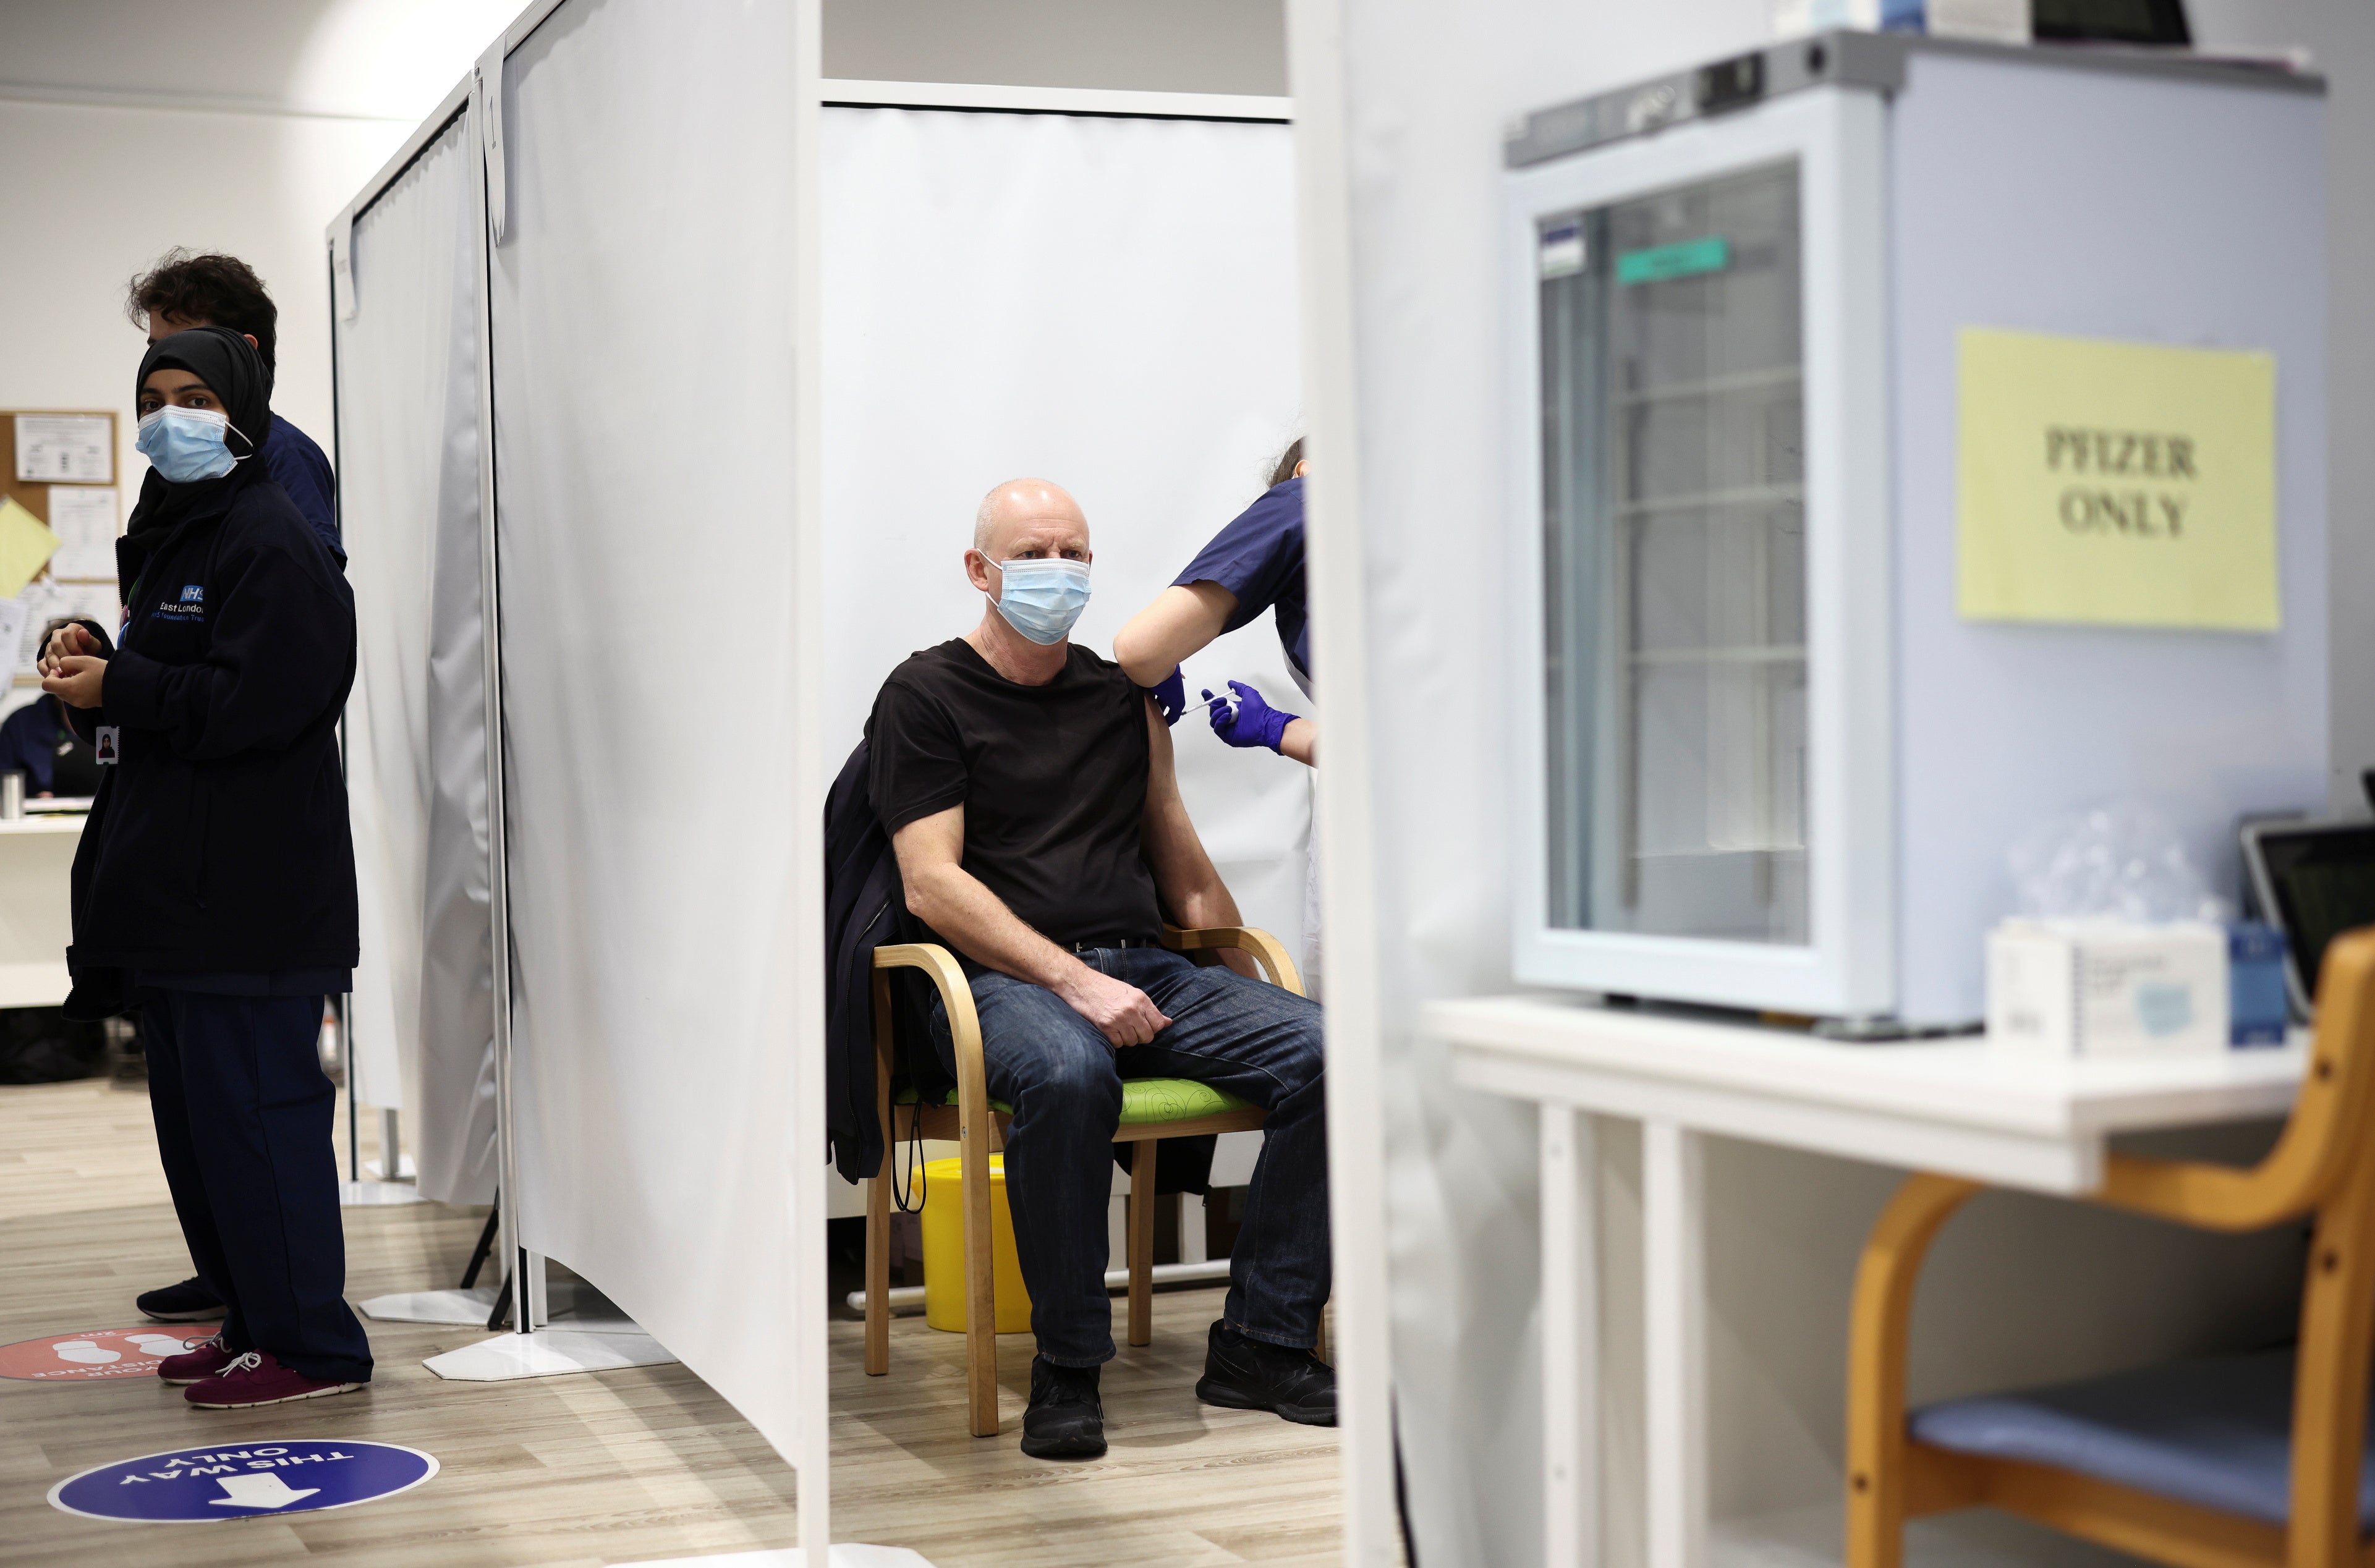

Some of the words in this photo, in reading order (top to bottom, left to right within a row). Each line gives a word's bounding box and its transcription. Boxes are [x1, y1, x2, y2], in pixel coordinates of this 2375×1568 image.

[2045, 426, 2199, 480] PFIZER
[2058, 486, 2189, 538] ONLY
[181, 587, 203, 601] NHS
[159, 602, 177, 612] East
[32, 1360, 163, 1378] DISTANCE
[88, 1366, 158, 1377] YOUR
[163, 1447, 289, 1468] ONLY
[247, 1451, 354, 1468] THIS
[119, 1464, 239, 1485] WAY
